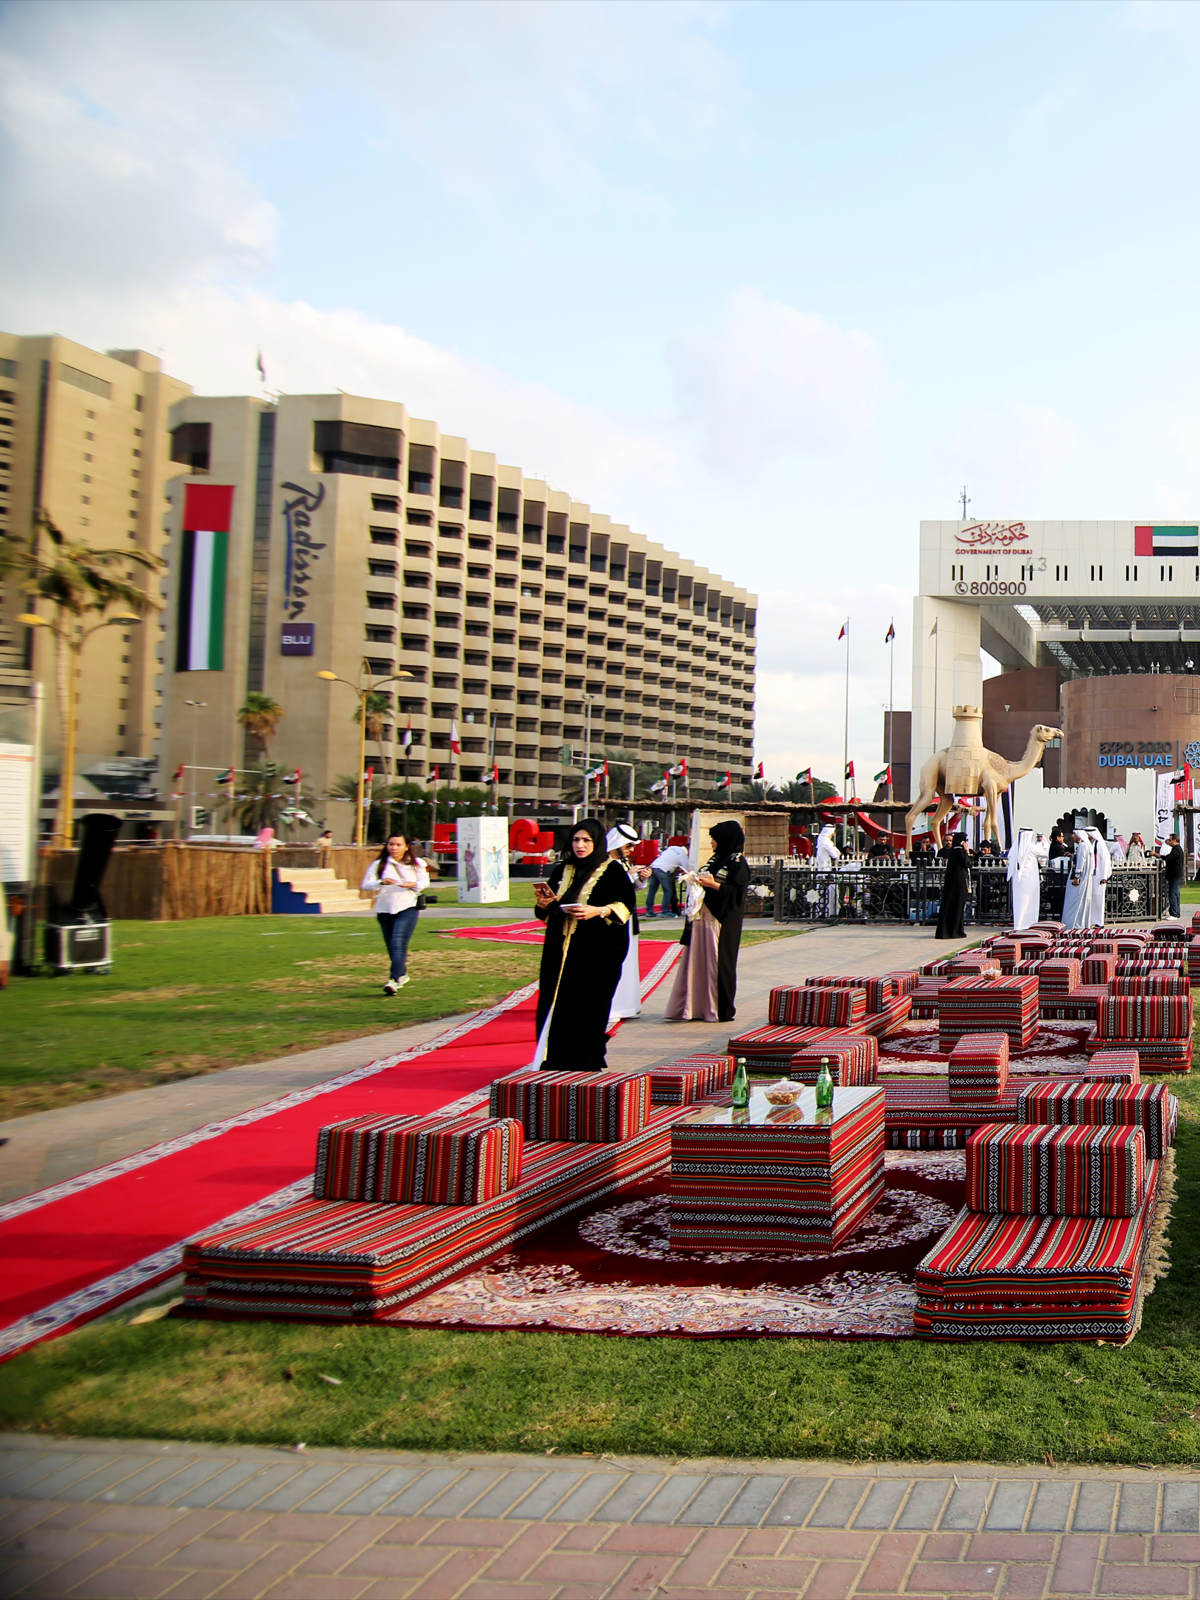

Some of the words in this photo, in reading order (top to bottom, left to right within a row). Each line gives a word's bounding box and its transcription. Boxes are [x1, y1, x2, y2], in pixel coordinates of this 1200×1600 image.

[280, 481, 327, 620] Radisson
[970, 581, 1027, 595] 800900
[281, 634, 311, 645] BLU
[1099, 741, 1135, 754] EXPO
[1137, 741, 1173, 754] 2020
[1098, 755, 1142, 768] DUBAI,
[1144, 754, 1174, 767] UAE
